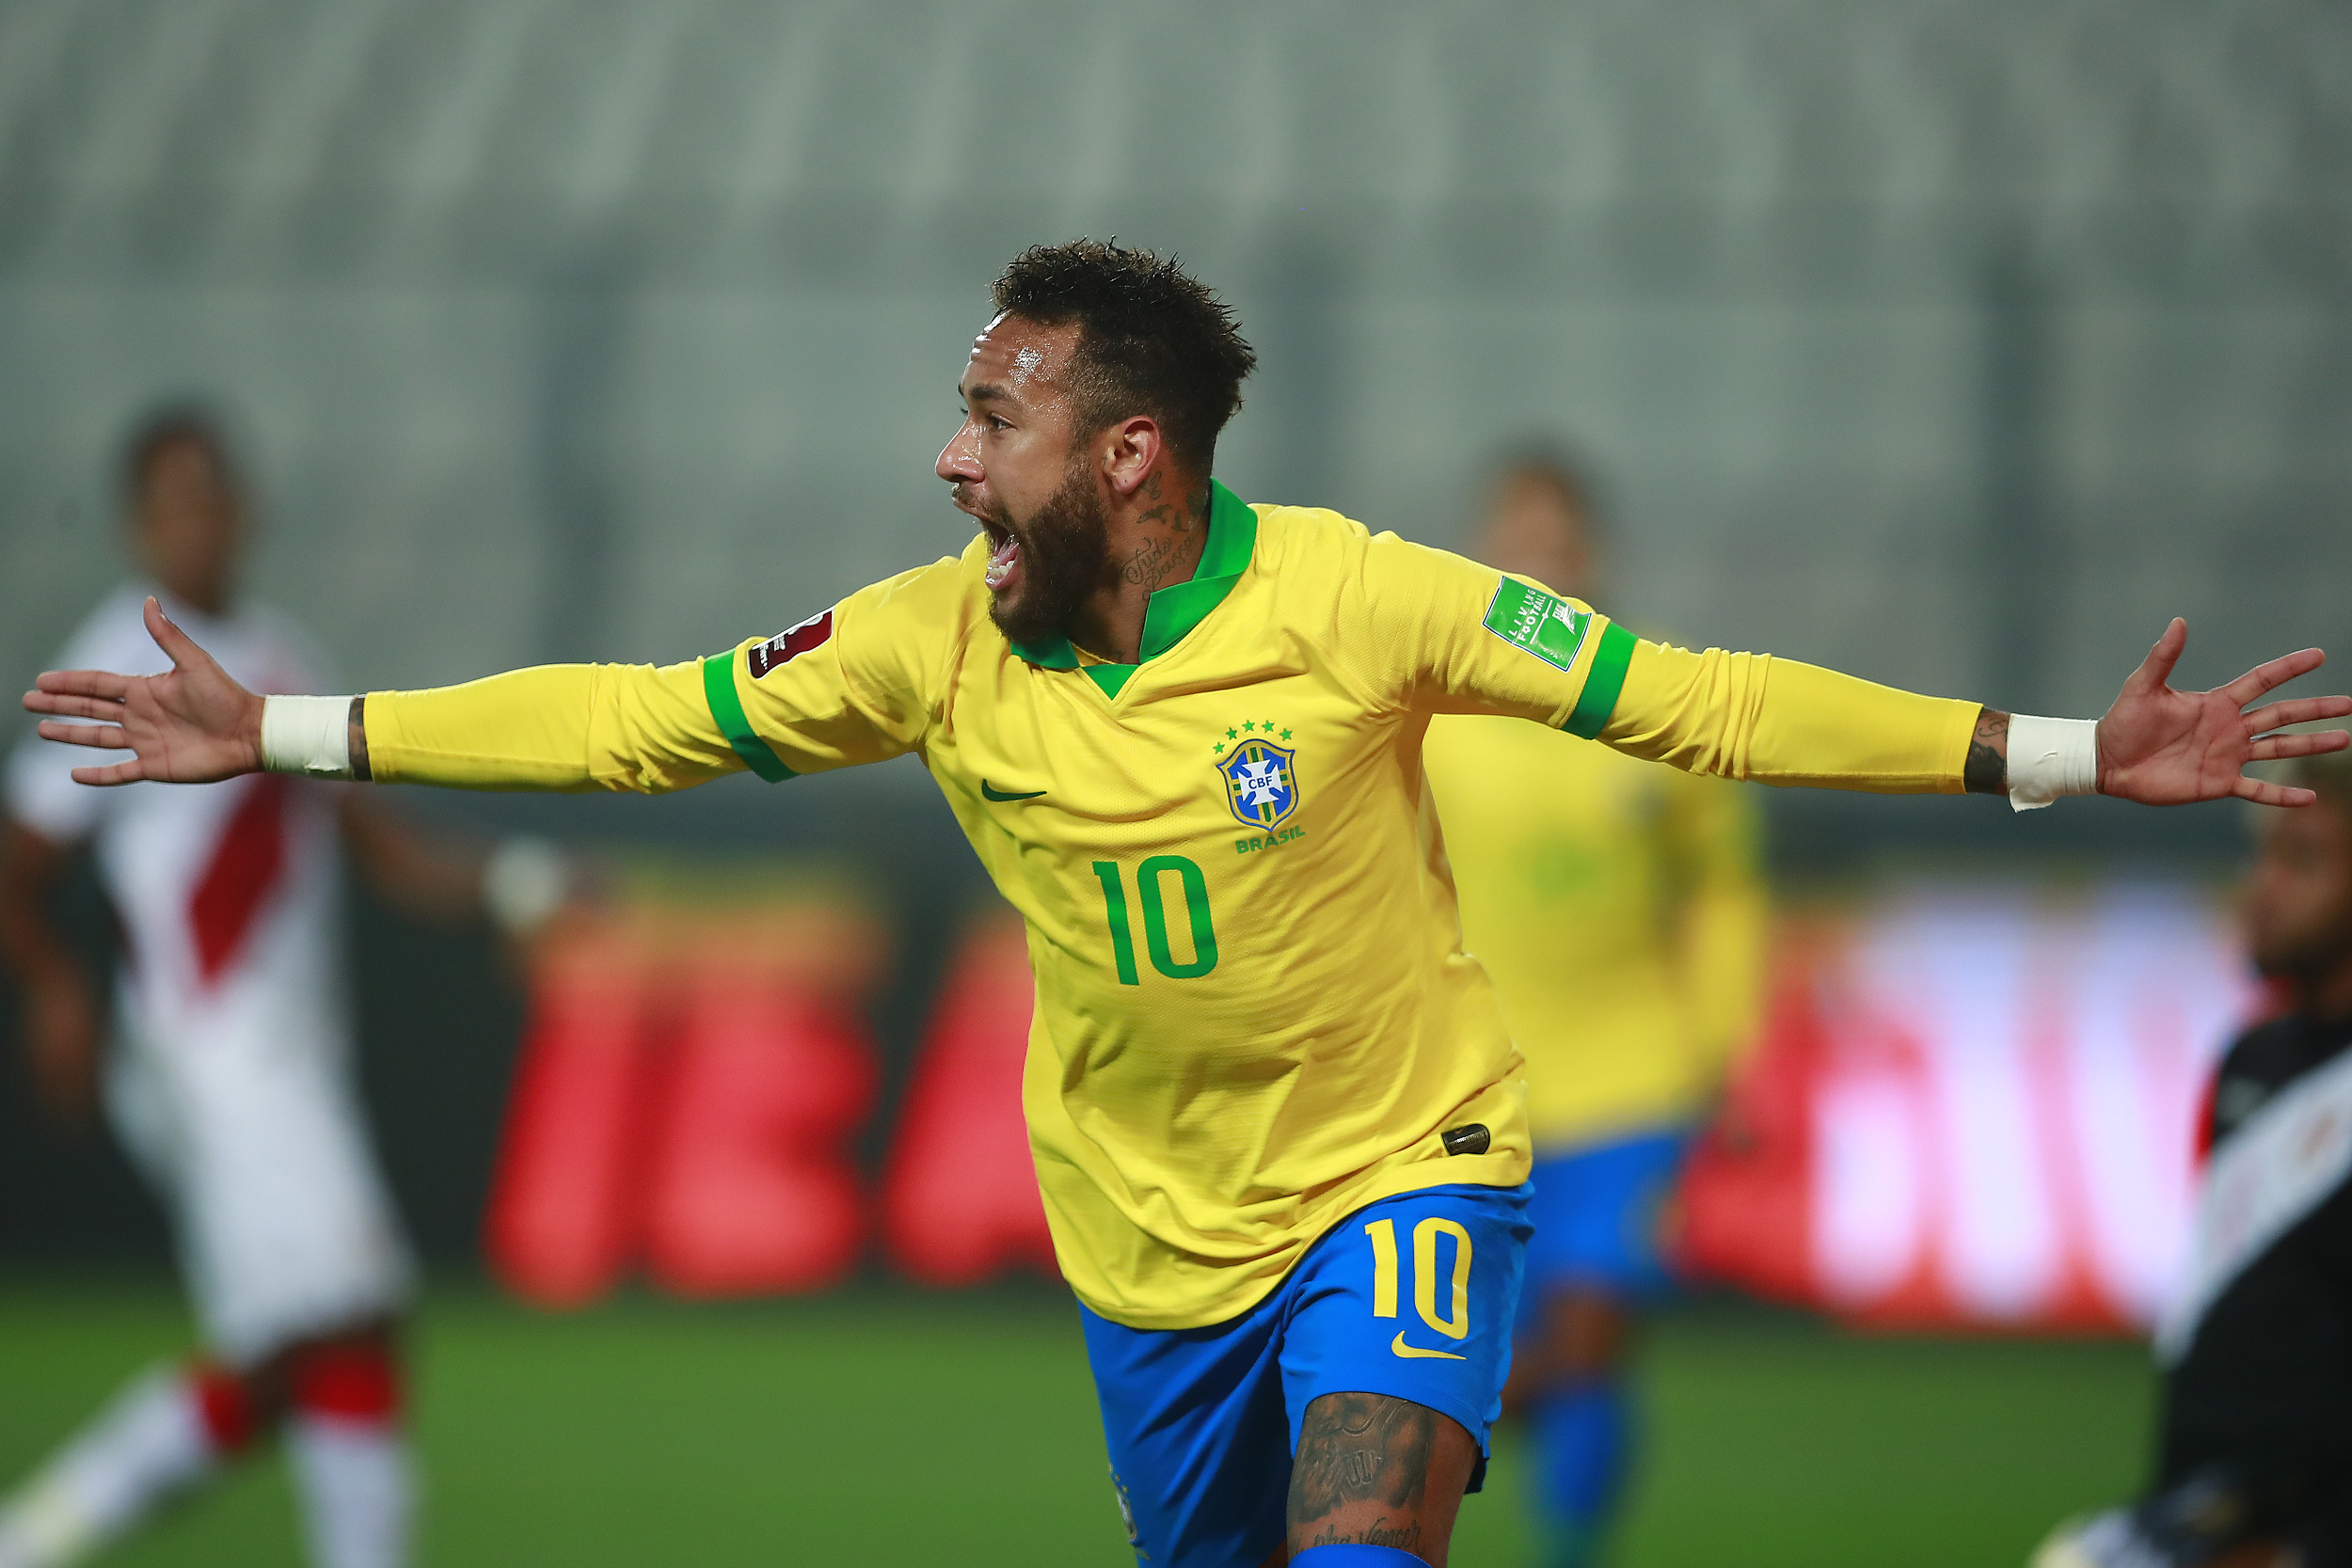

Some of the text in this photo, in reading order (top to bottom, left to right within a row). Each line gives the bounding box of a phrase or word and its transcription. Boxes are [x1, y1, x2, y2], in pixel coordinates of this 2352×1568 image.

[1248, 775, 1273, 790] CBF
[1235, 826, 1306, 854] BRASIL
[1091, 855, 1218, 986] 10
[1364, 1217, 1473, 1340] 10
